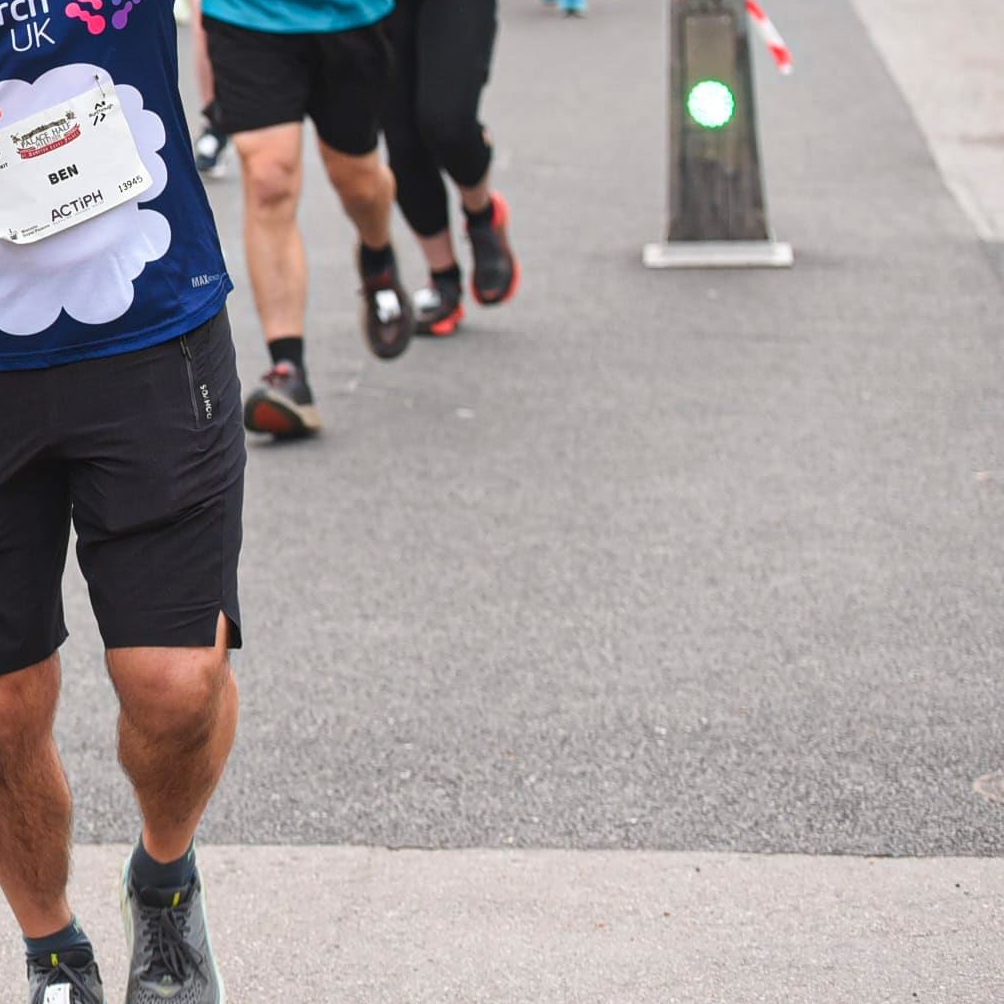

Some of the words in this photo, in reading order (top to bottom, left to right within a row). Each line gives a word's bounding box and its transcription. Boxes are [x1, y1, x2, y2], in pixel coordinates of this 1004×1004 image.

[10, 17, 55, 52] UK
[48, 163, 79, 185] BEN
[118, 175, 144, 194] 13945
